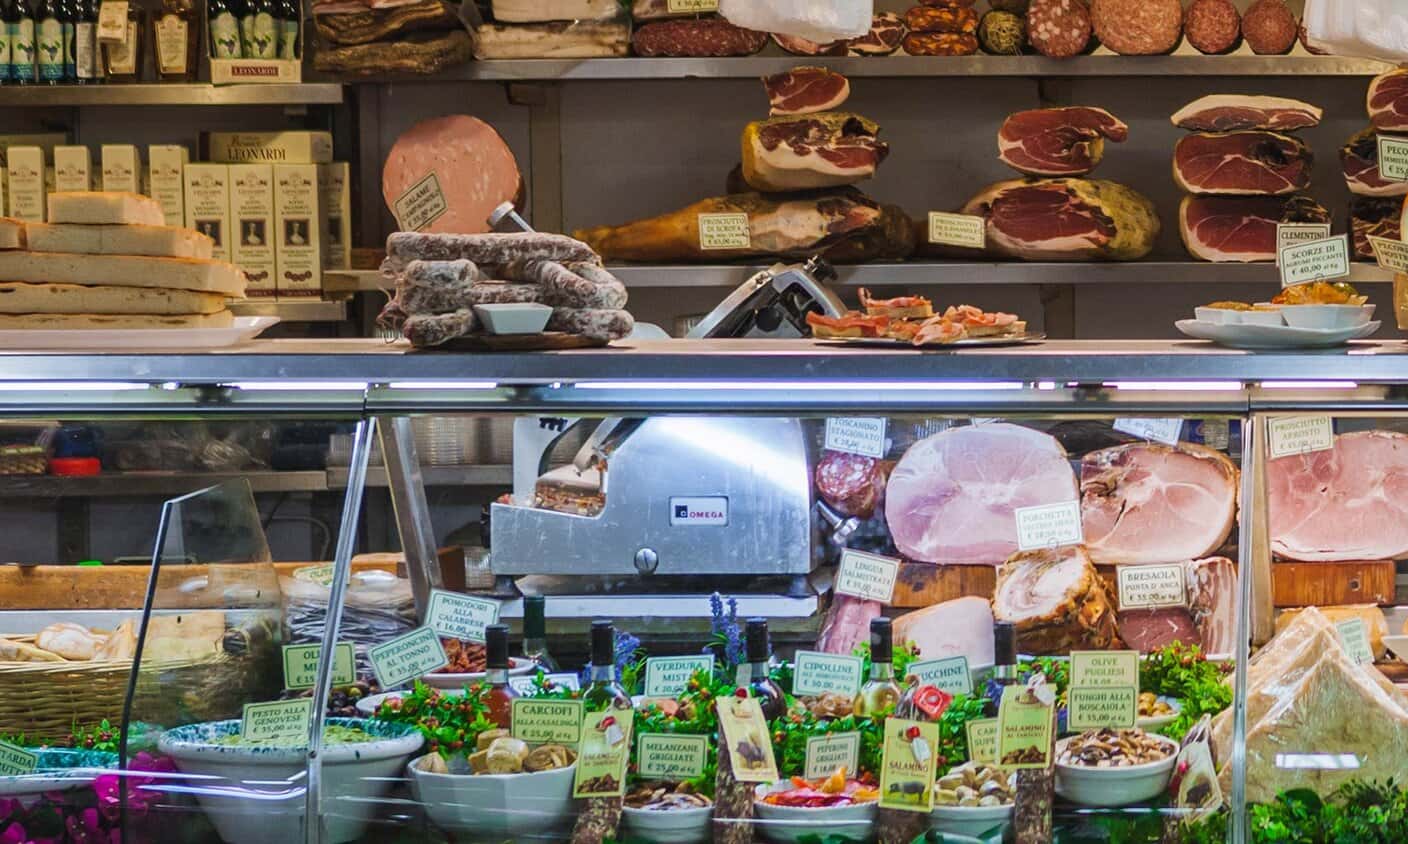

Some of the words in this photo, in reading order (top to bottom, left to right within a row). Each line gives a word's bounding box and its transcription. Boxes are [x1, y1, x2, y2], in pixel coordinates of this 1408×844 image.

[227, 148, 286, 160] LEONARDI
[1291, 247, 1322, 259] SCORZE
[1326, 244, 1336, 253] DI
[1128, 571, 1176, 581] BRESAOLA
[655, 662, 703, 671] VERDURA
[1091, 658, 1117, 666] OLIVE
[803, 663, 853, 674] CIPOLLINE
[1075, 694, 1107, 702] FUNGHI
[1111, 693, 1131, 701] ALLA
[253, 709, 281, 718] PESTO
[522, 705, 572, 715] CARCIOFI
[646, 743, 699, 752] MELANZANE
[649, 752, 695, 762] GRIGLIATE
[888, 760, 929, 773] SALAMINO
